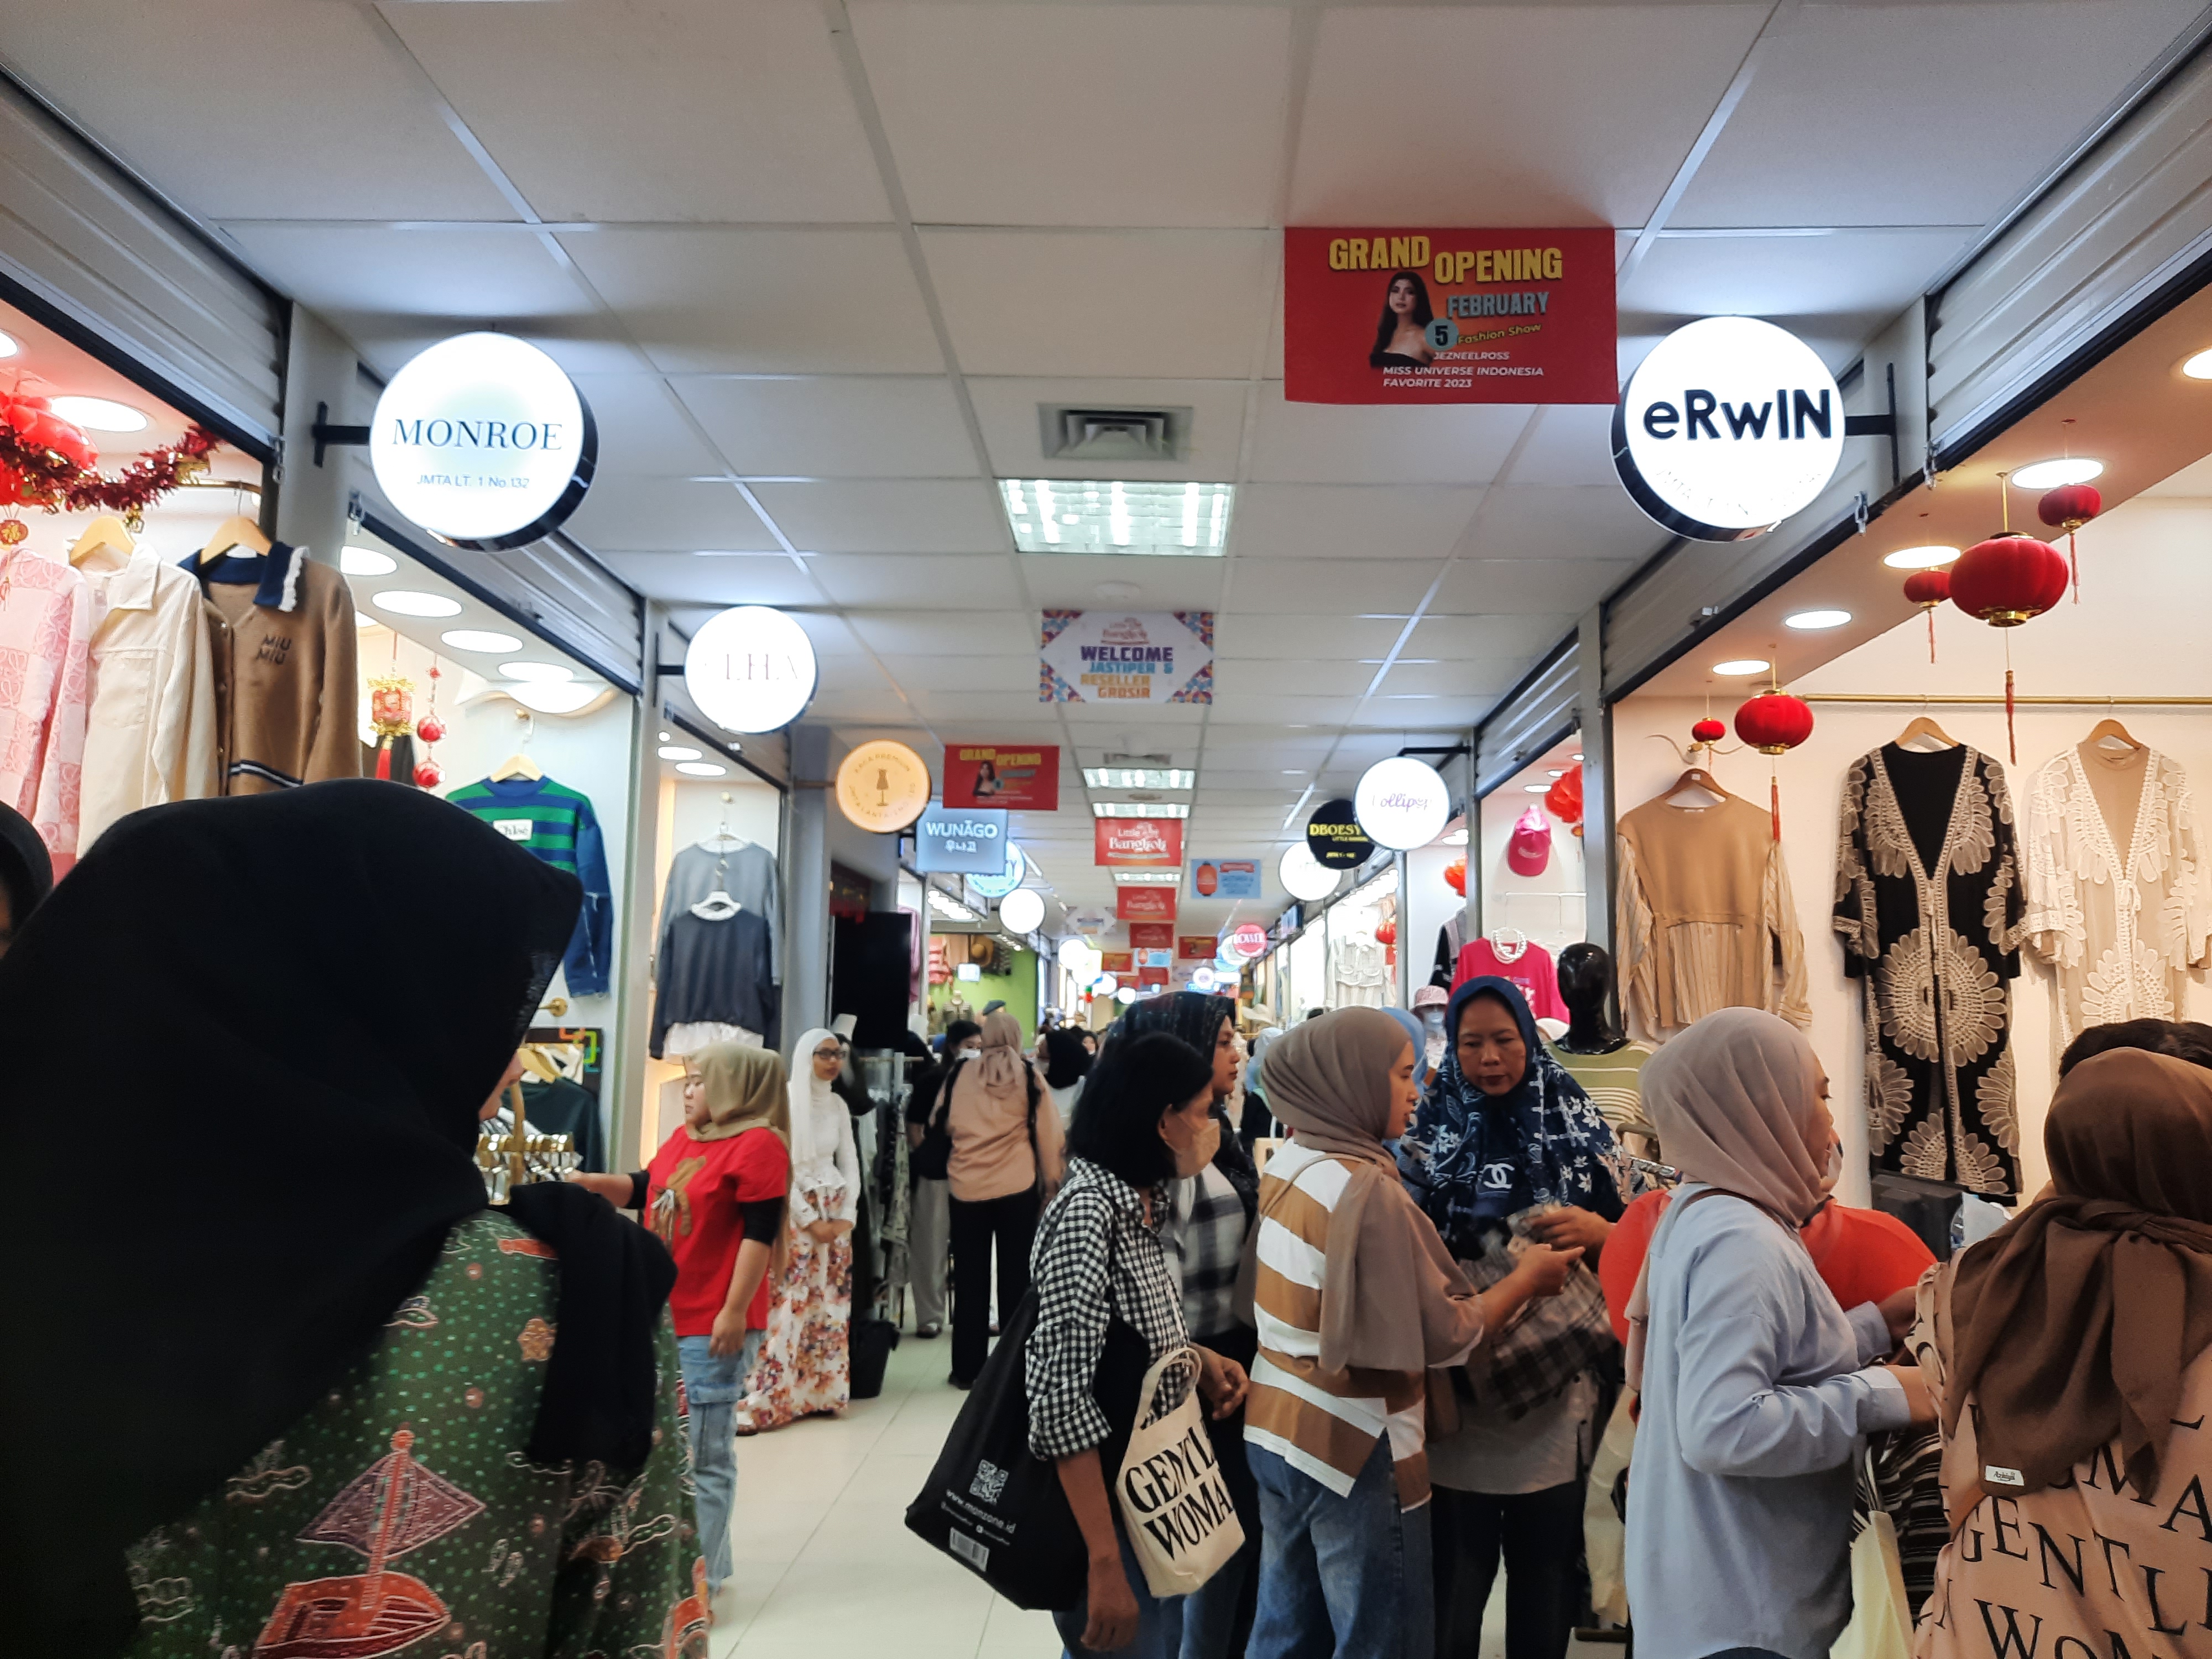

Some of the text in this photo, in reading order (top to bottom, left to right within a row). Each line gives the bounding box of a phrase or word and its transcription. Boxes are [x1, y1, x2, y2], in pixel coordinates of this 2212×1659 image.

[1329, 236, 1564, 284] GRAND OPENING
[1447, 291, 1549, 319] FEBRUARY
[1433, 324, 1449, 347] 5
[1457, 324, 1542, 346] Fashion Show
[1383, 366, 1545, 377] MISS UNIVERSE INDONESIA
[1383, 378, 1473, 388] FAVORITE 2023
[1643, 389, 1833, 441] eRwIN
[392, 419, 563, 451] MONROE
[416, 474, 452, 486] JMTA
[261, 634, 291, 651] MIU
[255, 648, 286, 665] MIU
[1081, 646, 1173, 662] WELCOME
